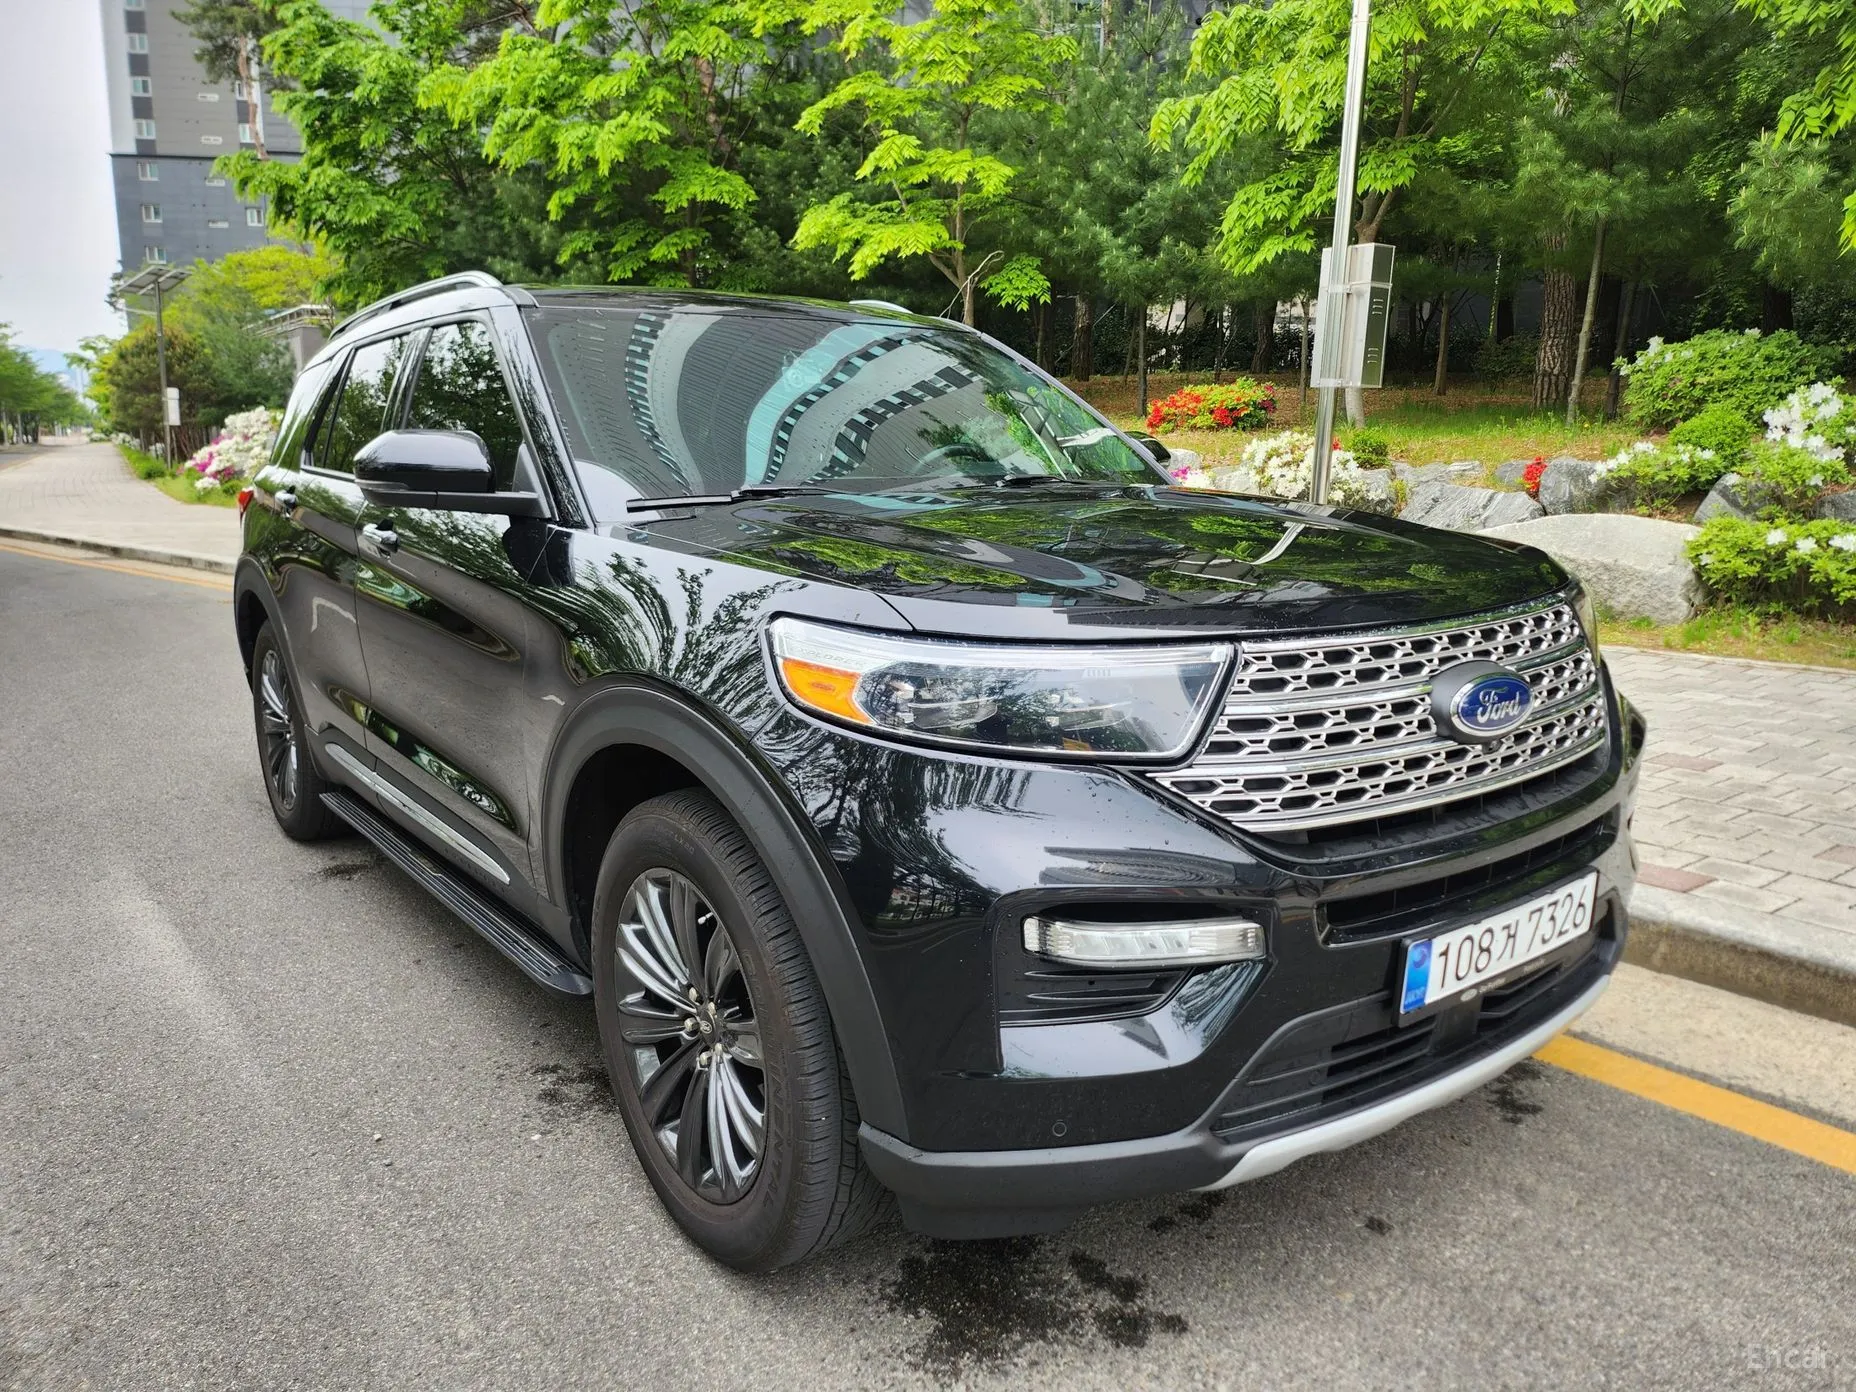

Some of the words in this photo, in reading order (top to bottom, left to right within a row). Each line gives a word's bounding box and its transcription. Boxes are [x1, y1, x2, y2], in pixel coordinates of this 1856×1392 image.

[1477, 686, 1520, 723] Ford
[1438, 919, 1519, 989] 108거
[1527, 885, 1587, 953] 7326
